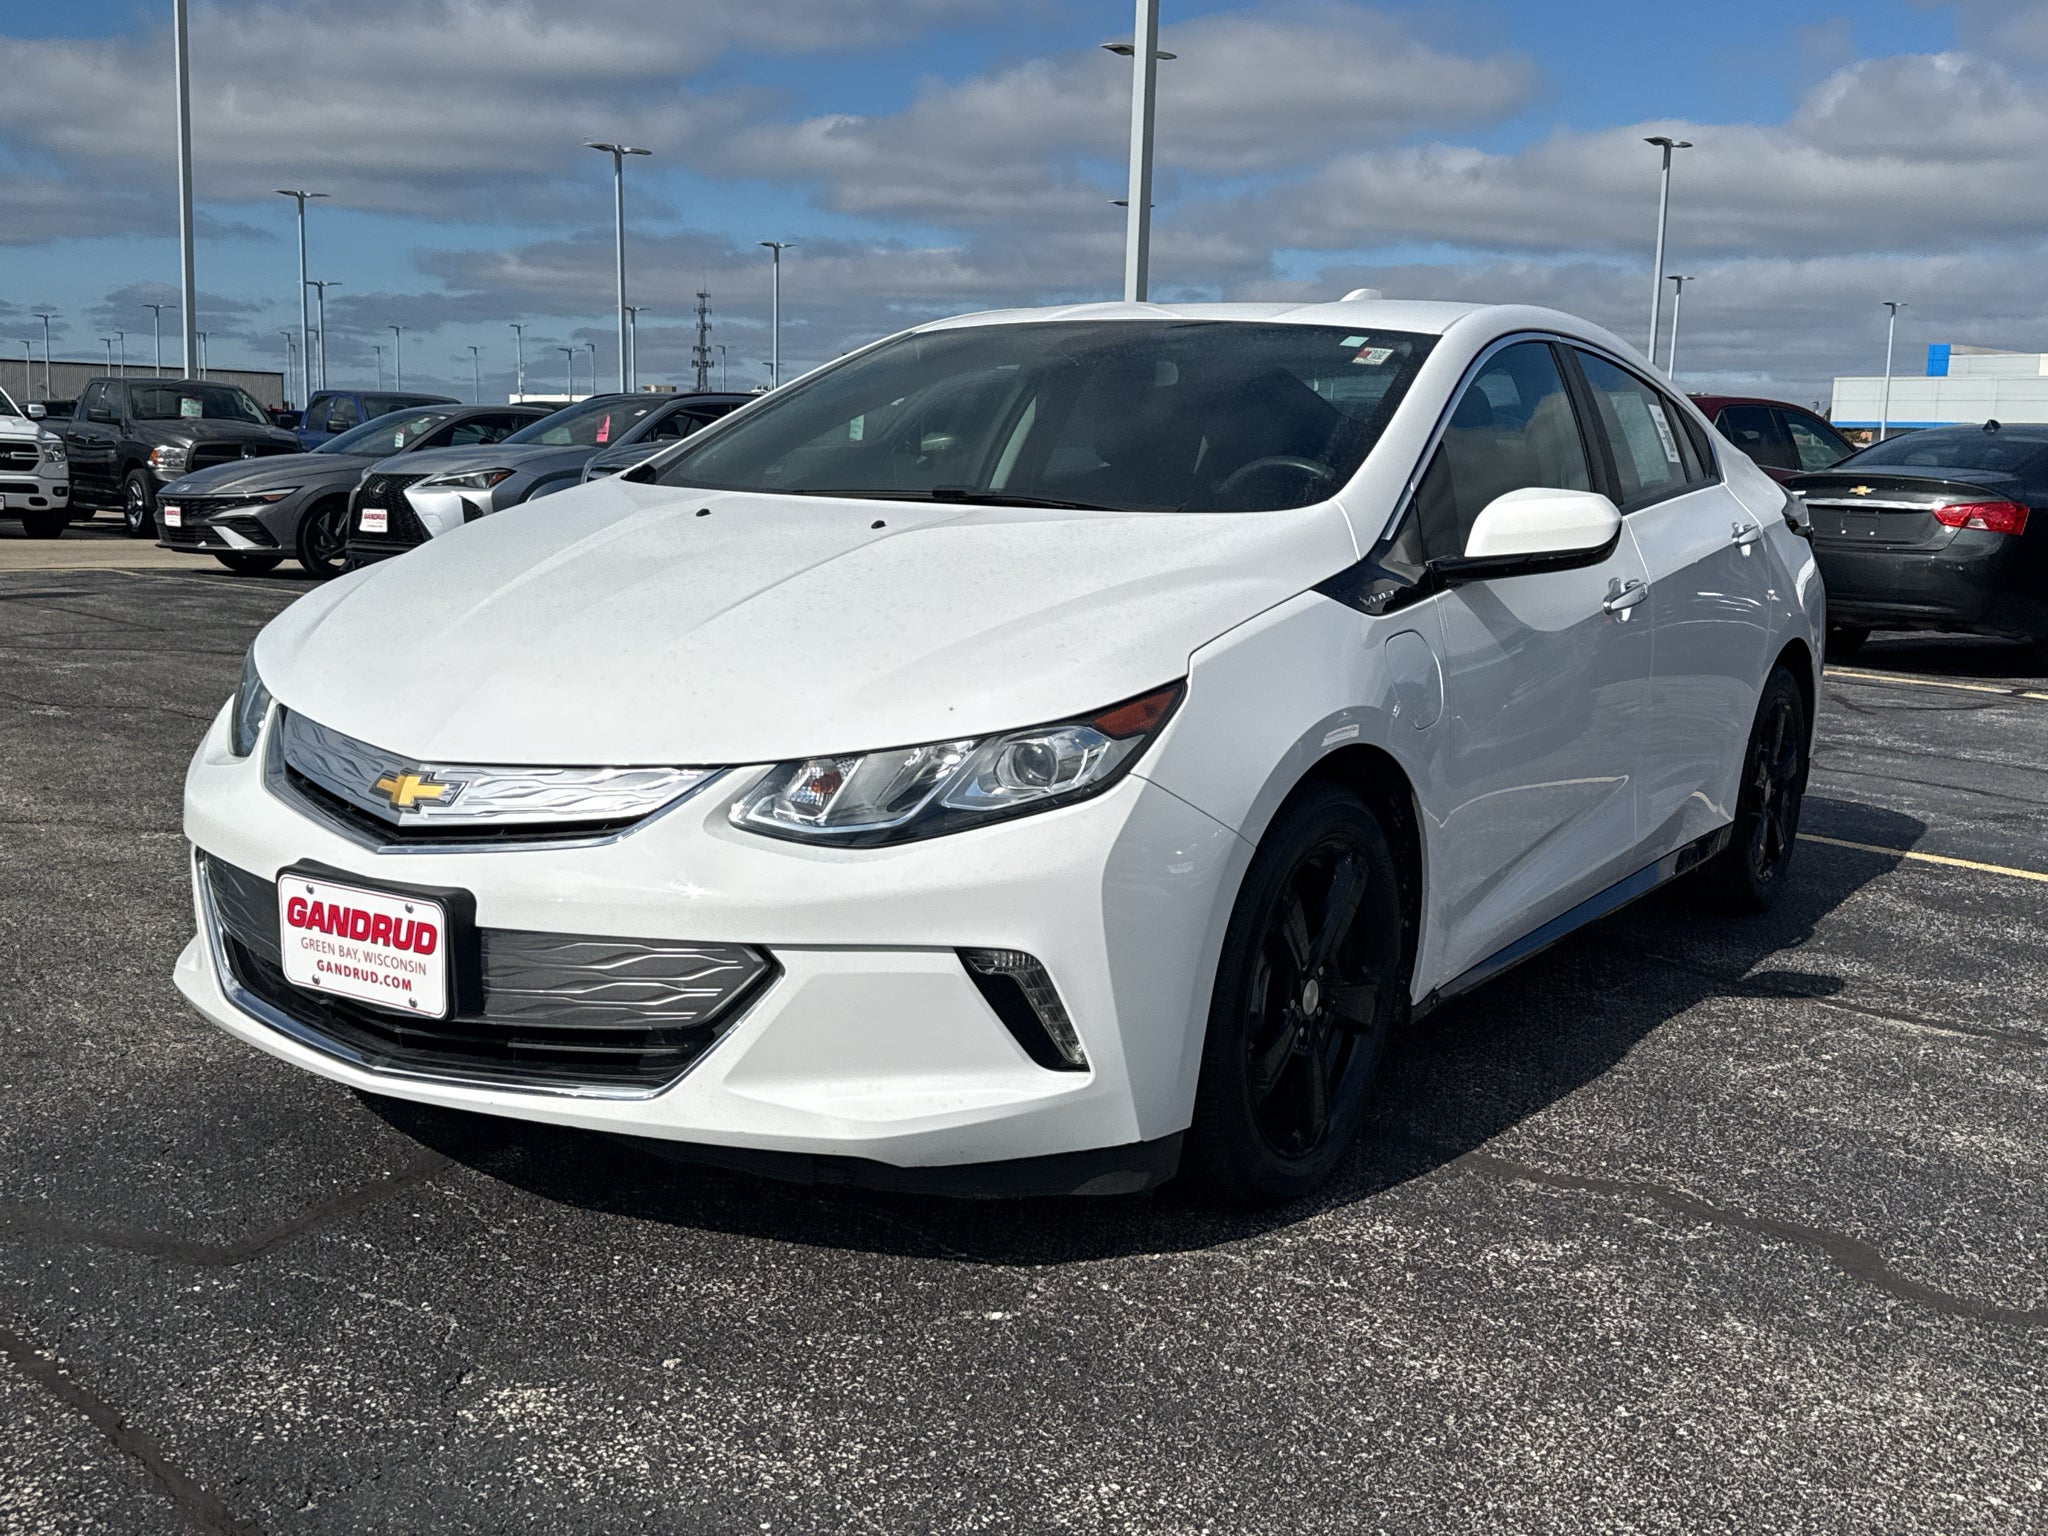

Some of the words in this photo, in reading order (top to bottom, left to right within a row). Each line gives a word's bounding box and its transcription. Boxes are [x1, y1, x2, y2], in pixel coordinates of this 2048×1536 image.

[287, 896, 437, 955] GANDRUD
[301, 937, 336, 956] GREEN
[339, 944, 361, 962] BAY,
[362, 950, 427, 976] WISCONSIN
[316, 959, 412, 991] GANDRUD.COM
